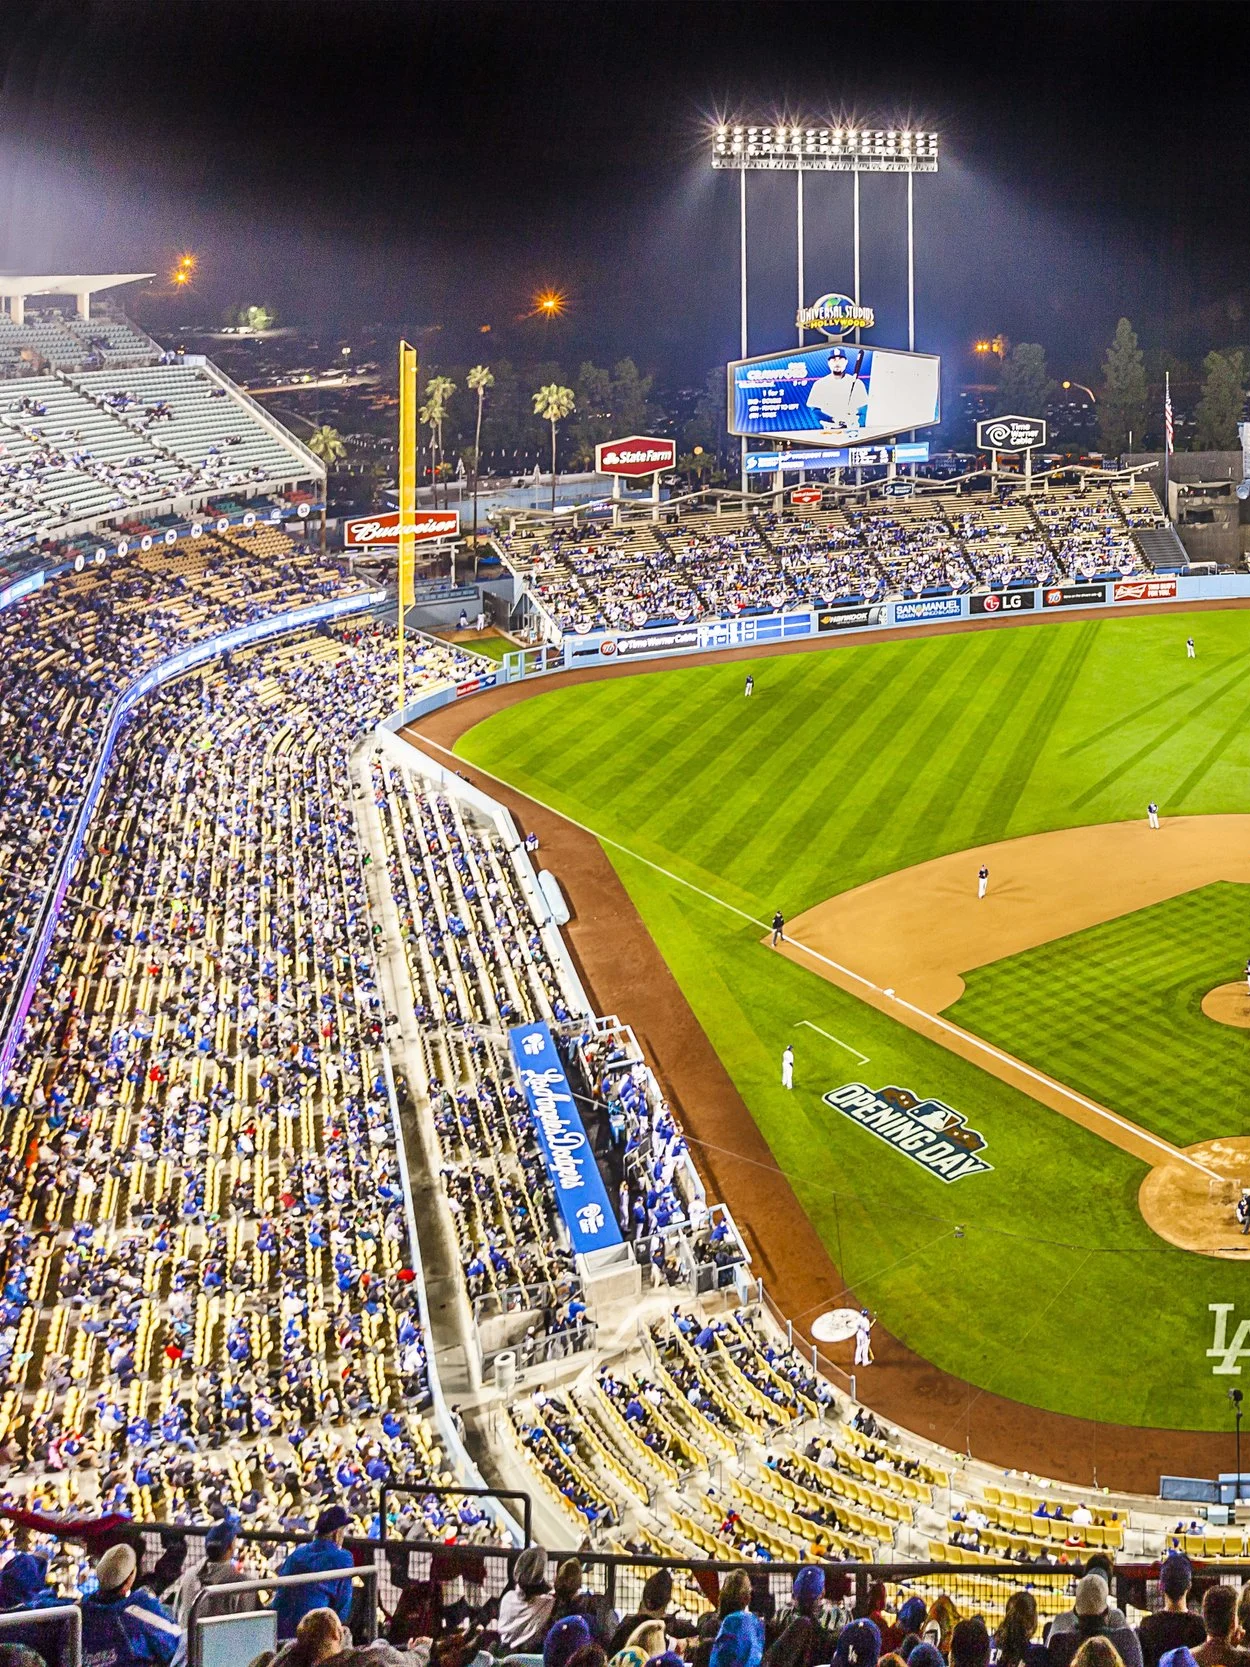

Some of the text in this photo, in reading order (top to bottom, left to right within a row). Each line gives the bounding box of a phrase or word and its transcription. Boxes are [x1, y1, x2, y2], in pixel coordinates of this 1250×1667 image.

[798, 304, 875, 322] UNIVERSAL STUDIOS
[810, 319, 866, 329] HOLLYWOOD
[1010, 422, 1031, 431] Time
[1010, 430, 1039, 438] Warner
[619, 449, 672, 464] State Farm
[350, 519, 457, 542] Budweiser
[896, 600, 958, 615] SAN MANUEL
[1002, 595, 1021, 608] LG
[827, 1084, 986, 1179] OPENING DAY
[548, 1131, 586, 1190] Dodgers
